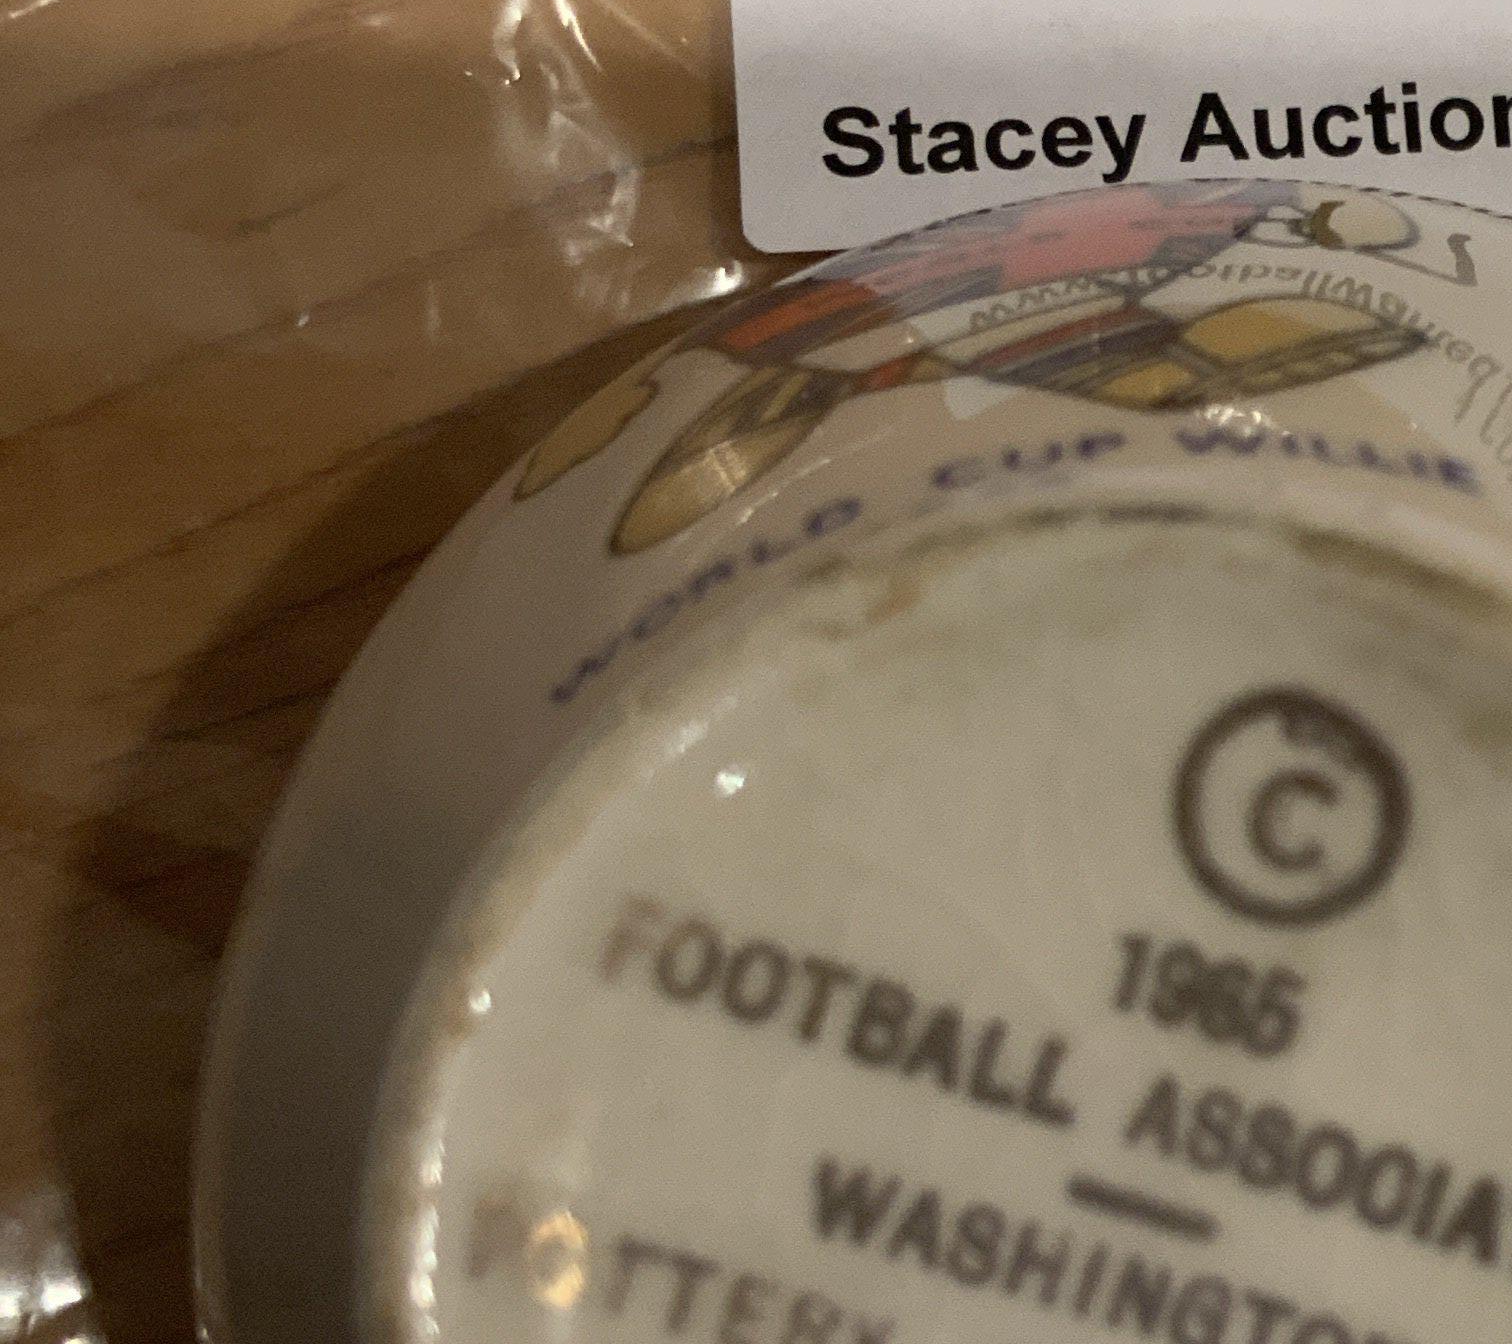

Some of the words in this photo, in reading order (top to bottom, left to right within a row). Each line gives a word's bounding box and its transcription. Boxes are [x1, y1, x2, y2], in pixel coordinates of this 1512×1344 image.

[821, 103, 1145, 183] Stacey
[548, 496, 863, 702] WORLD
[931, 430, 1126, 490] CUP
[1174, 426, 1484, 498] WILLIE
[600, 894, 1077, 1129] FOOTBALL
[1114, 932, 1306, 1058] 1965
